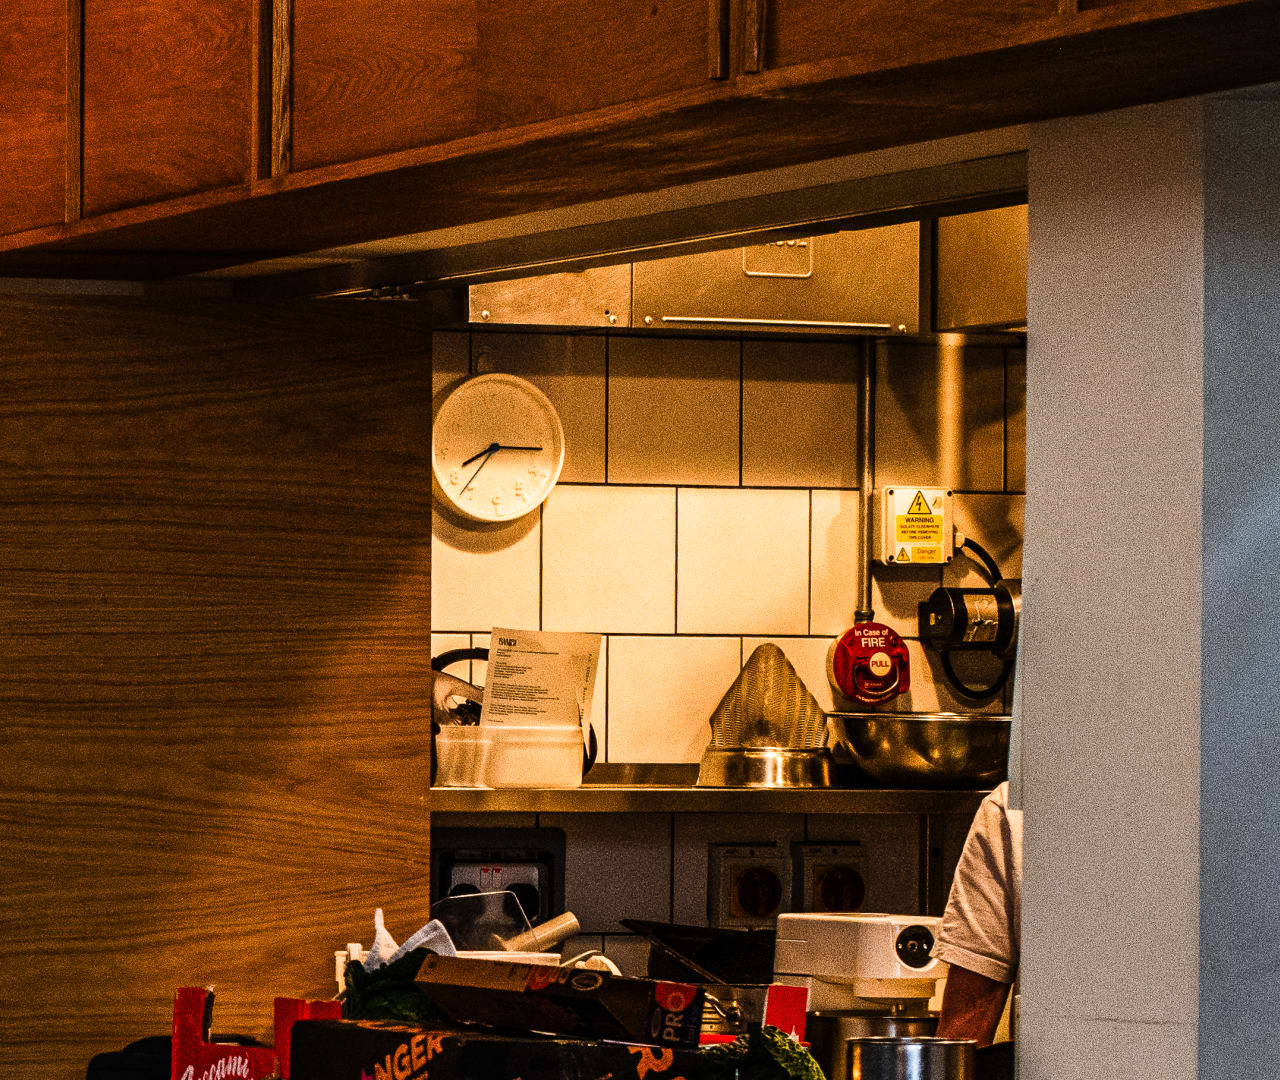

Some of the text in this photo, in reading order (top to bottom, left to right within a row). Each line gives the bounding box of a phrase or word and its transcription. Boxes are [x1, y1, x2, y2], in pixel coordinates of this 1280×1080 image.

[854, 628, 889, 637] In Case of
[861, 637, 886, 648] FIRE
[871, 660, 889, 668] PULL
[663, 992, 685, 1042] PRO
